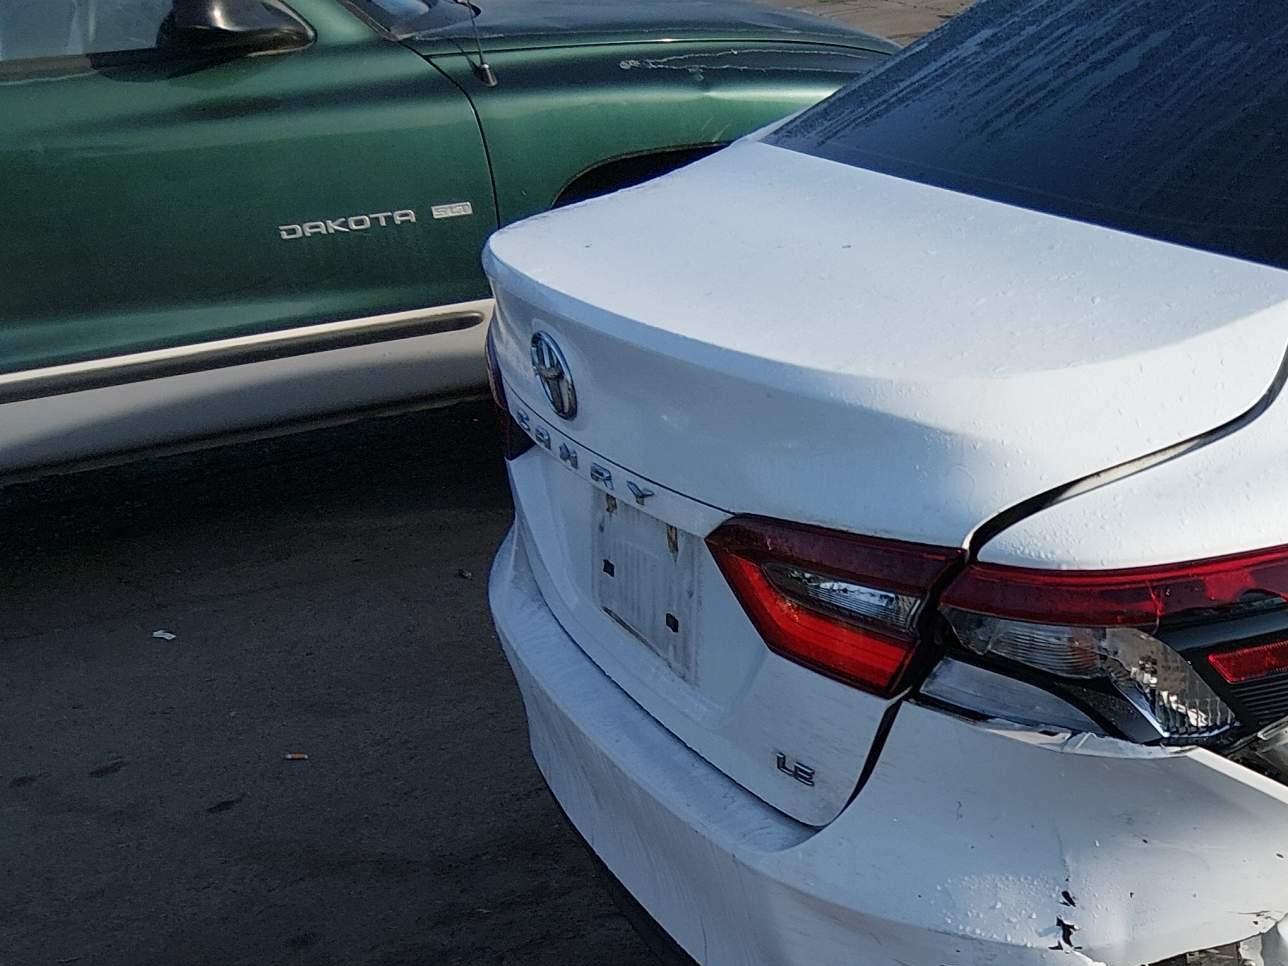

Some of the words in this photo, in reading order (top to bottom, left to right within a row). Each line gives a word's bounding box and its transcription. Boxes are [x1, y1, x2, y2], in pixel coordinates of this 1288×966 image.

[279, 209, 417, 240] DAKOTA
[516, 408, 655, 506] CAMRY
[776, 751, 815, 787] LE
